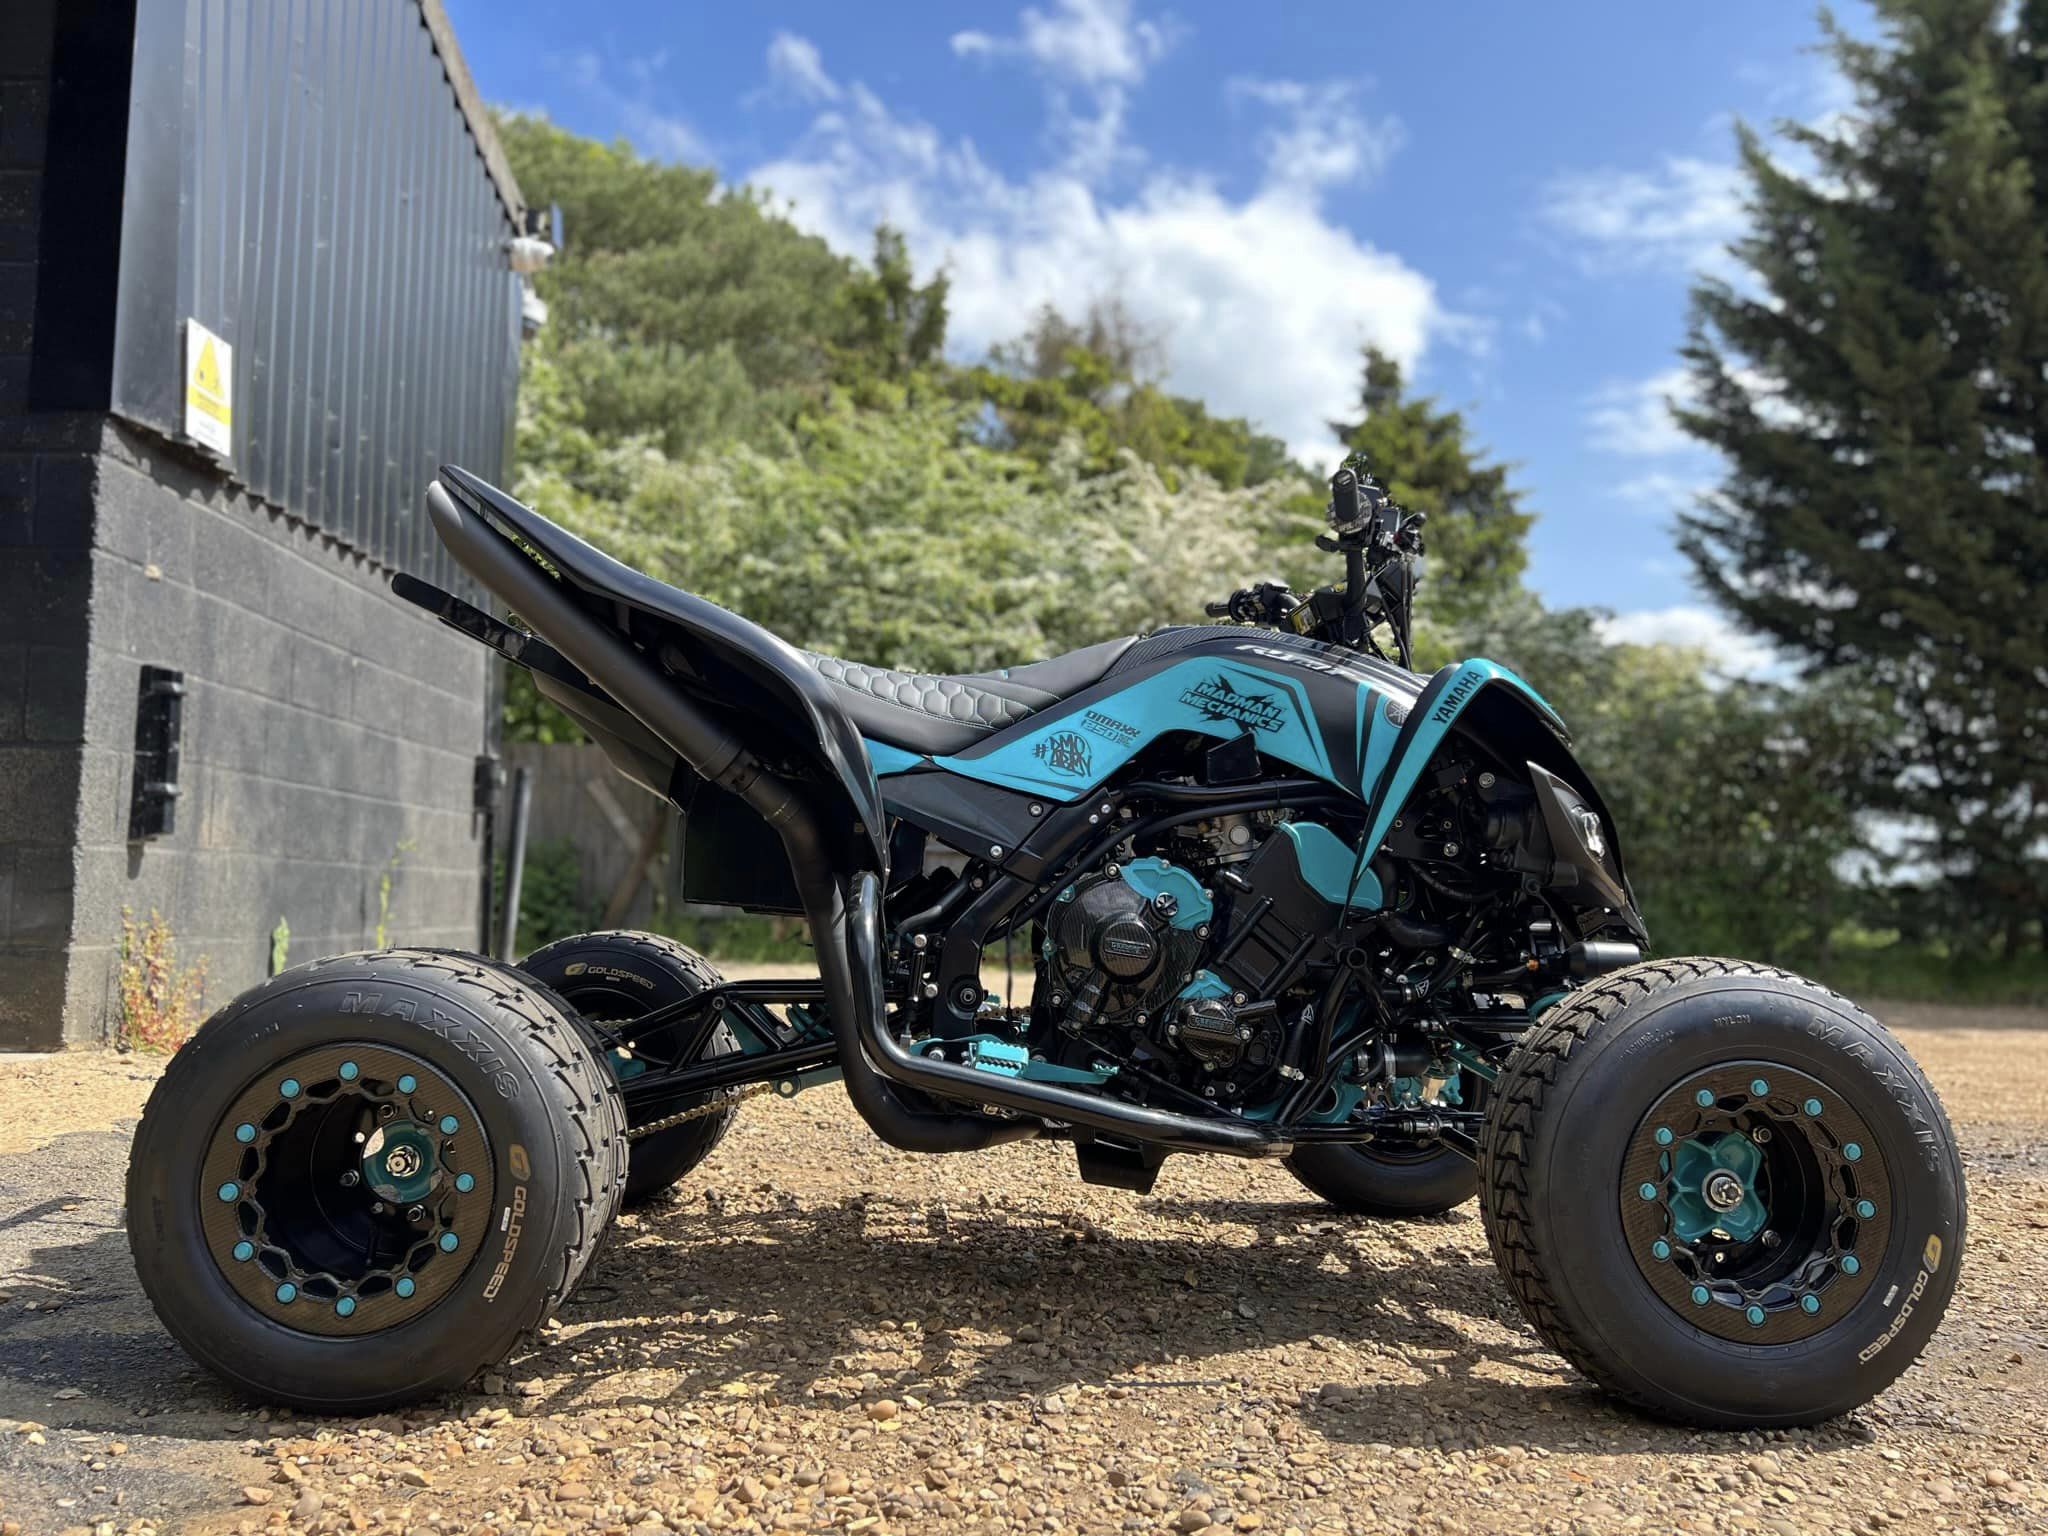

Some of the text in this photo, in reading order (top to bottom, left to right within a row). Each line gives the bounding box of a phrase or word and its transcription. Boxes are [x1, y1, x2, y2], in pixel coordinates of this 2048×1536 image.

[1180, 692, 1284, 732] MECHANICS
[1196, 683, 1281, 719] MADMAN
[1432, 671, 1483, 724] YAMAHA
[588, 966, 654, 990] GOLDSPEED
[338, 991, 521, 1099] MAXXIS
[1807, 1016, 1943, 1172] MAXXIS
[483, 1185, 527, 1299] GOLDSPEED
[1858, 1270, 1929, 1362] GOLDSPEED
